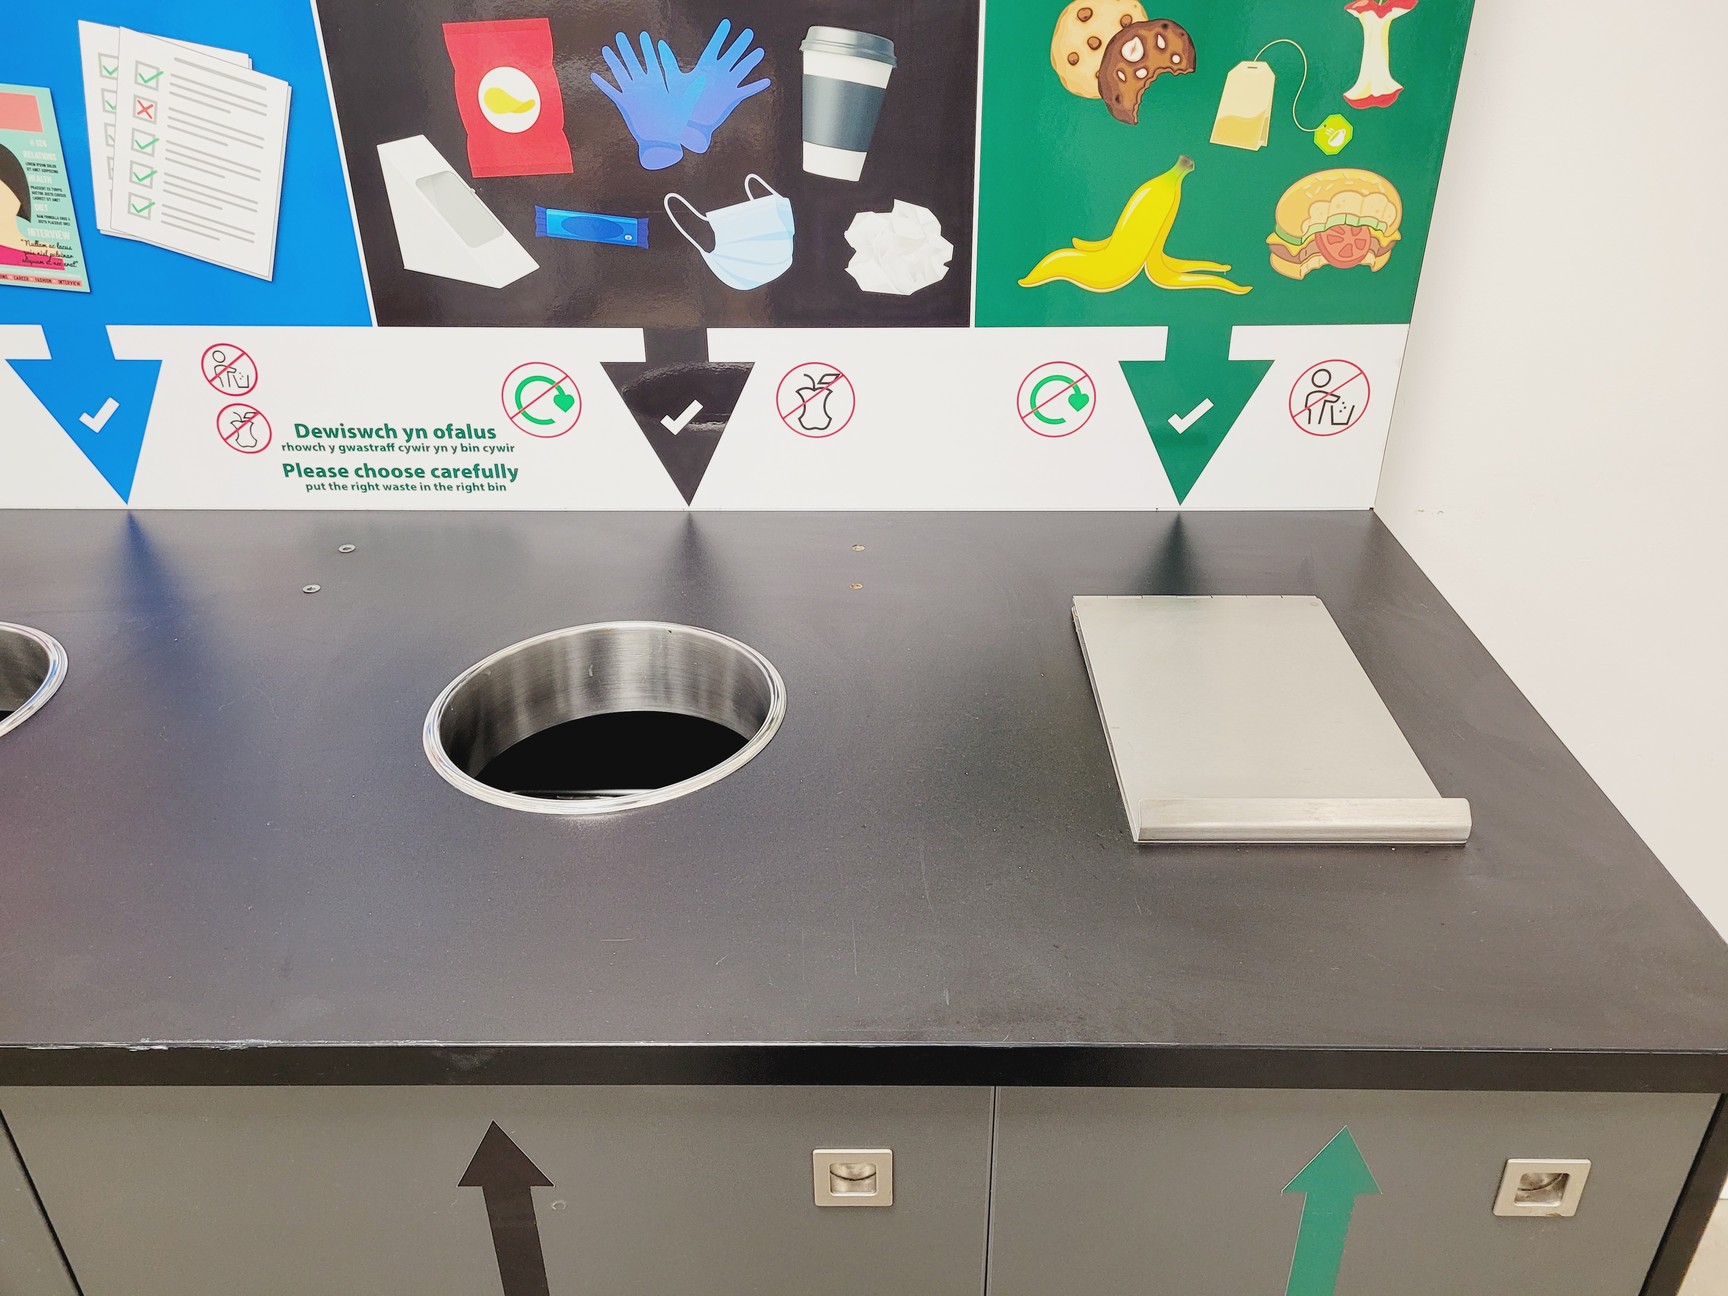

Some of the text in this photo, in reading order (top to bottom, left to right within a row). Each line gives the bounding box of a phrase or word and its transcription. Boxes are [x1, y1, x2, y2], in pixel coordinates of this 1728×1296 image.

[27, 228, 70, 240] INTERVIEW
[294, 423, 496, 444] Dewiswch yn ofalus
[282, 441, 514, 454] rhowch y gwastraff cywir yn y bin cywir
[283, 463, 518, 483] Please choose carefully
[306, 482, 506, 493] put the right waste in the right bin
